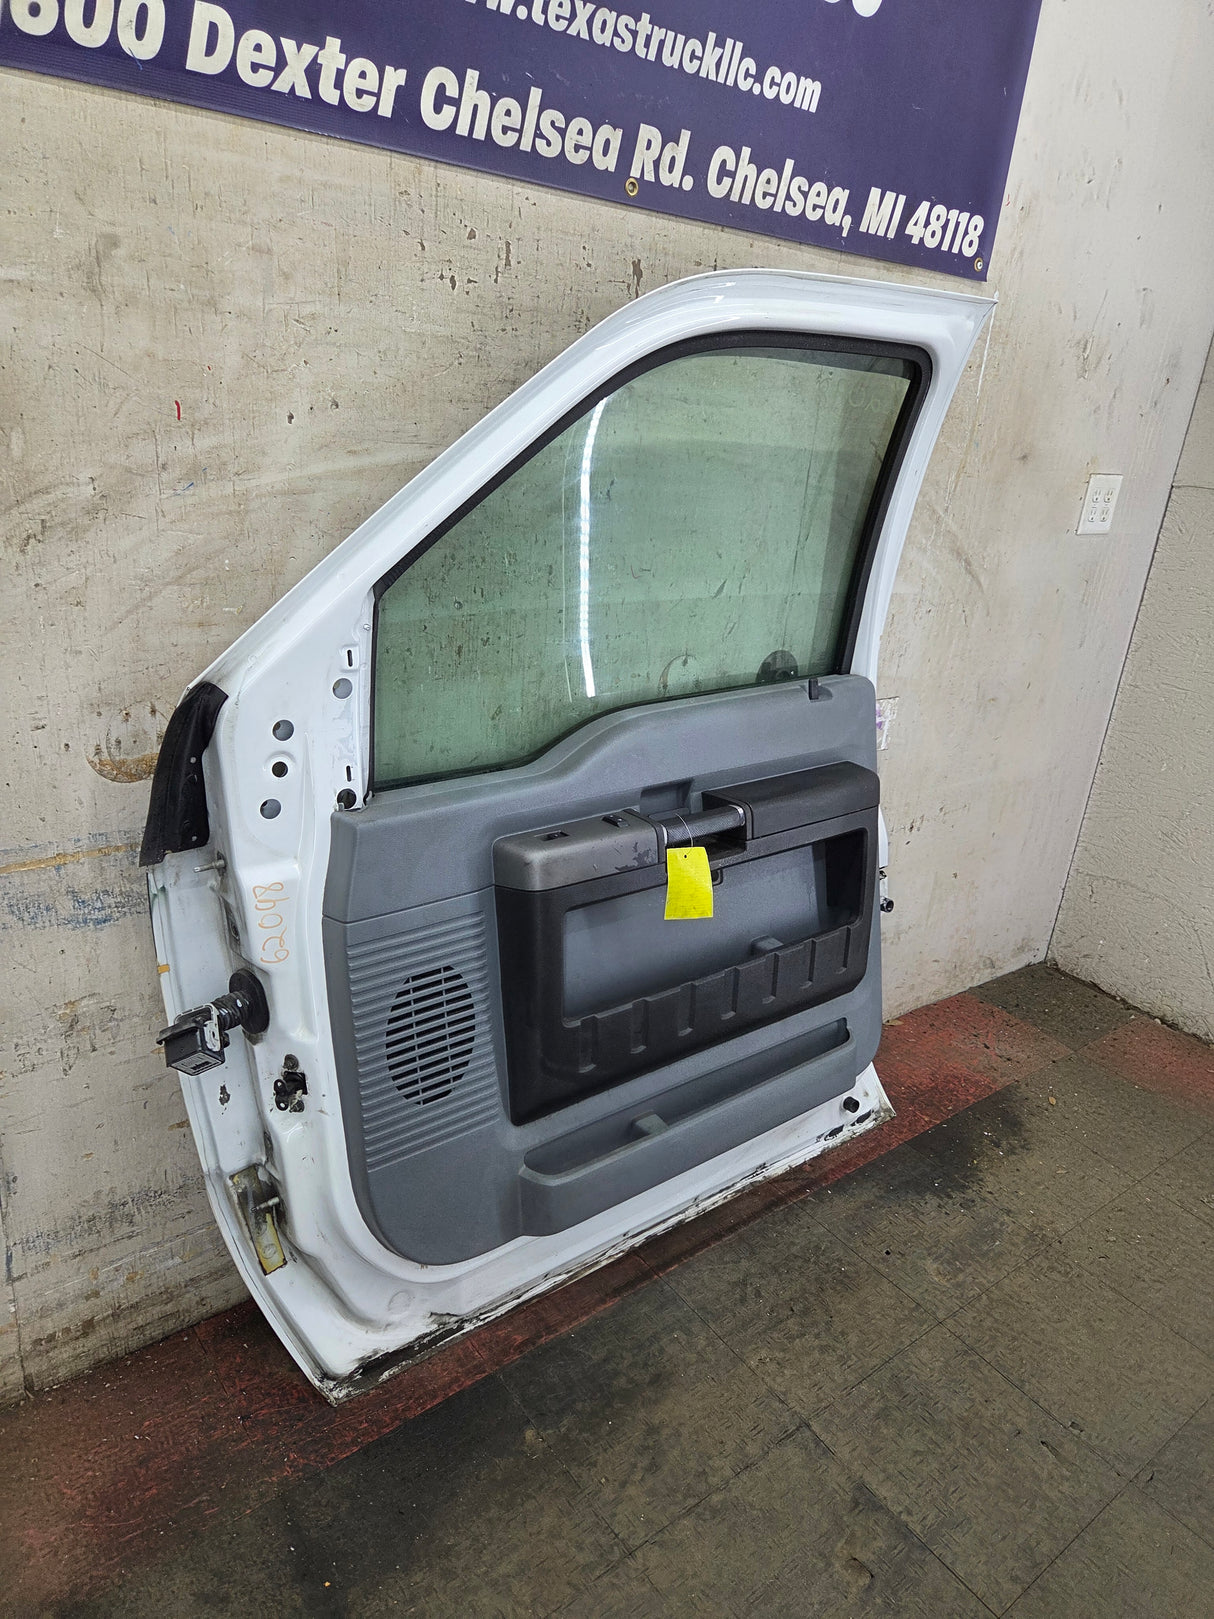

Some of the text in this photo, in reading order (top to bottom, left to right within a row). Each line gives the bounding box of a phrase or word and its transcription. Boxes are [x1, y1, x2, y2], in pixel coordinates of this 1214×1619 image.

[465, 0, 821, 113] .texastruckllc.com
[186, 0, 408, 119] Dexter
[421, 67, 624, 173] Chelsea
[630, 123, 694, 192] Rd.
[707, 146, 851, 237] Chelsea,
[859, 187, 907, 240] MI
[905, 201, 985, 257] 48118
[252, 881, 290, 964] 62048
